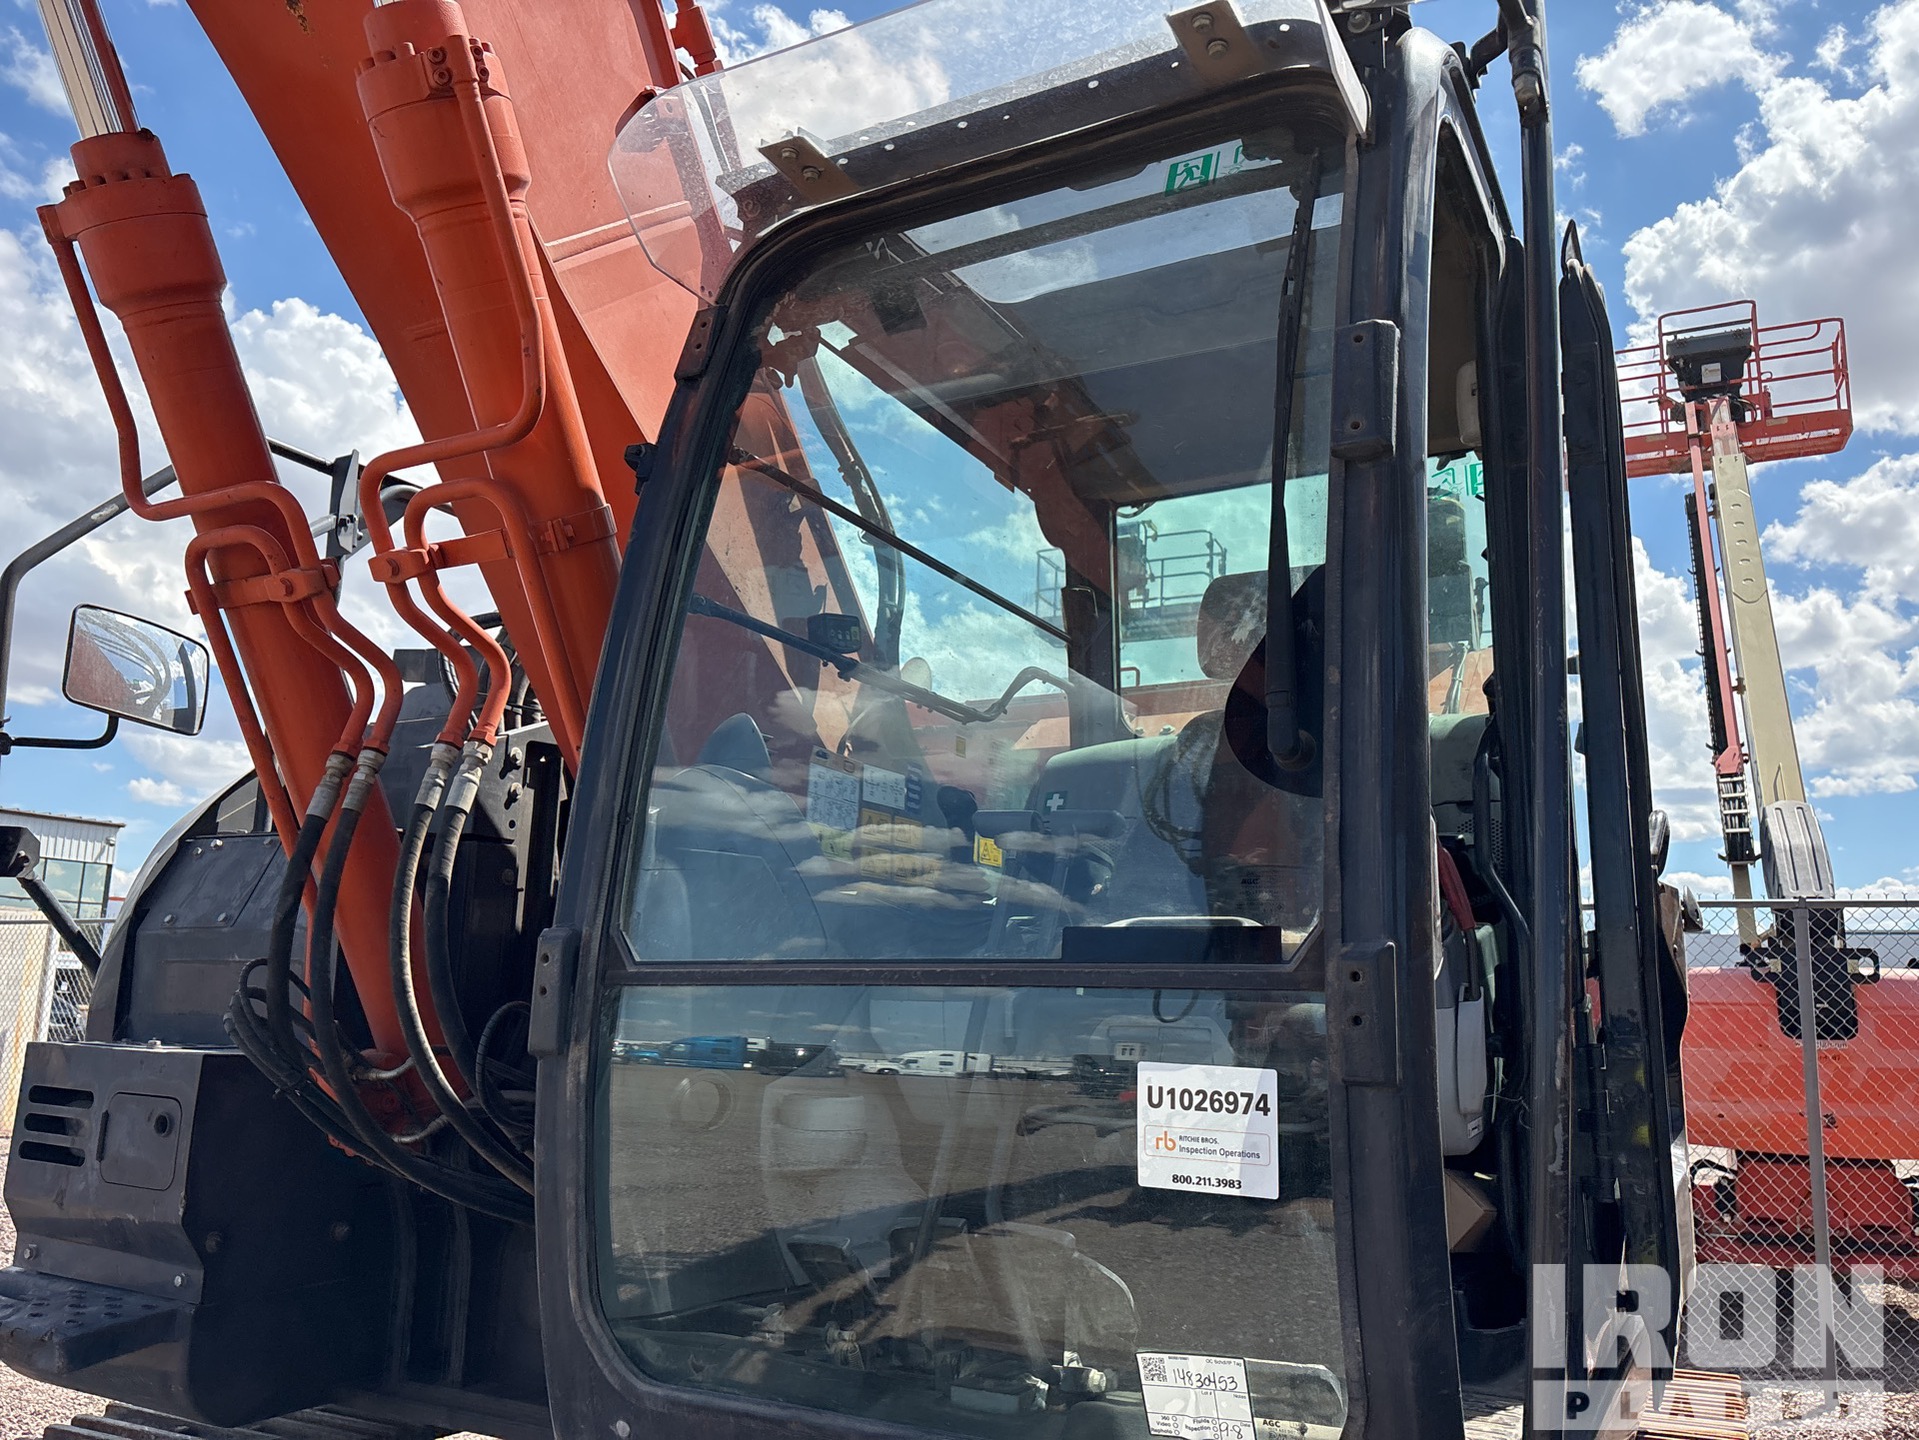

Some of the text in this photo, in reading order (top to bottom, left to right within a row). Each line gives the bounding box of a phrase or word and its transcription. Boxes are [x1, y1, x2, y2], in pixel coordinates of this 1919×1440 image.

[1147, 1085, 1271, 1116] U1026974
[1155, 1131, 1177, 1151] rb
[1179, 1135, 1219, 1145] RITCHIE BROS.
[1179, 1145, 1261, 1159] Inspection Operations
[1172, 1174, 1242, 1190] 800.211.3983
[1185, 1424, 1211, 1432] Inspection
[1219, 1421, 1243, 1440] 9-8
[1262, 1419, 1281, 1428] AGC
